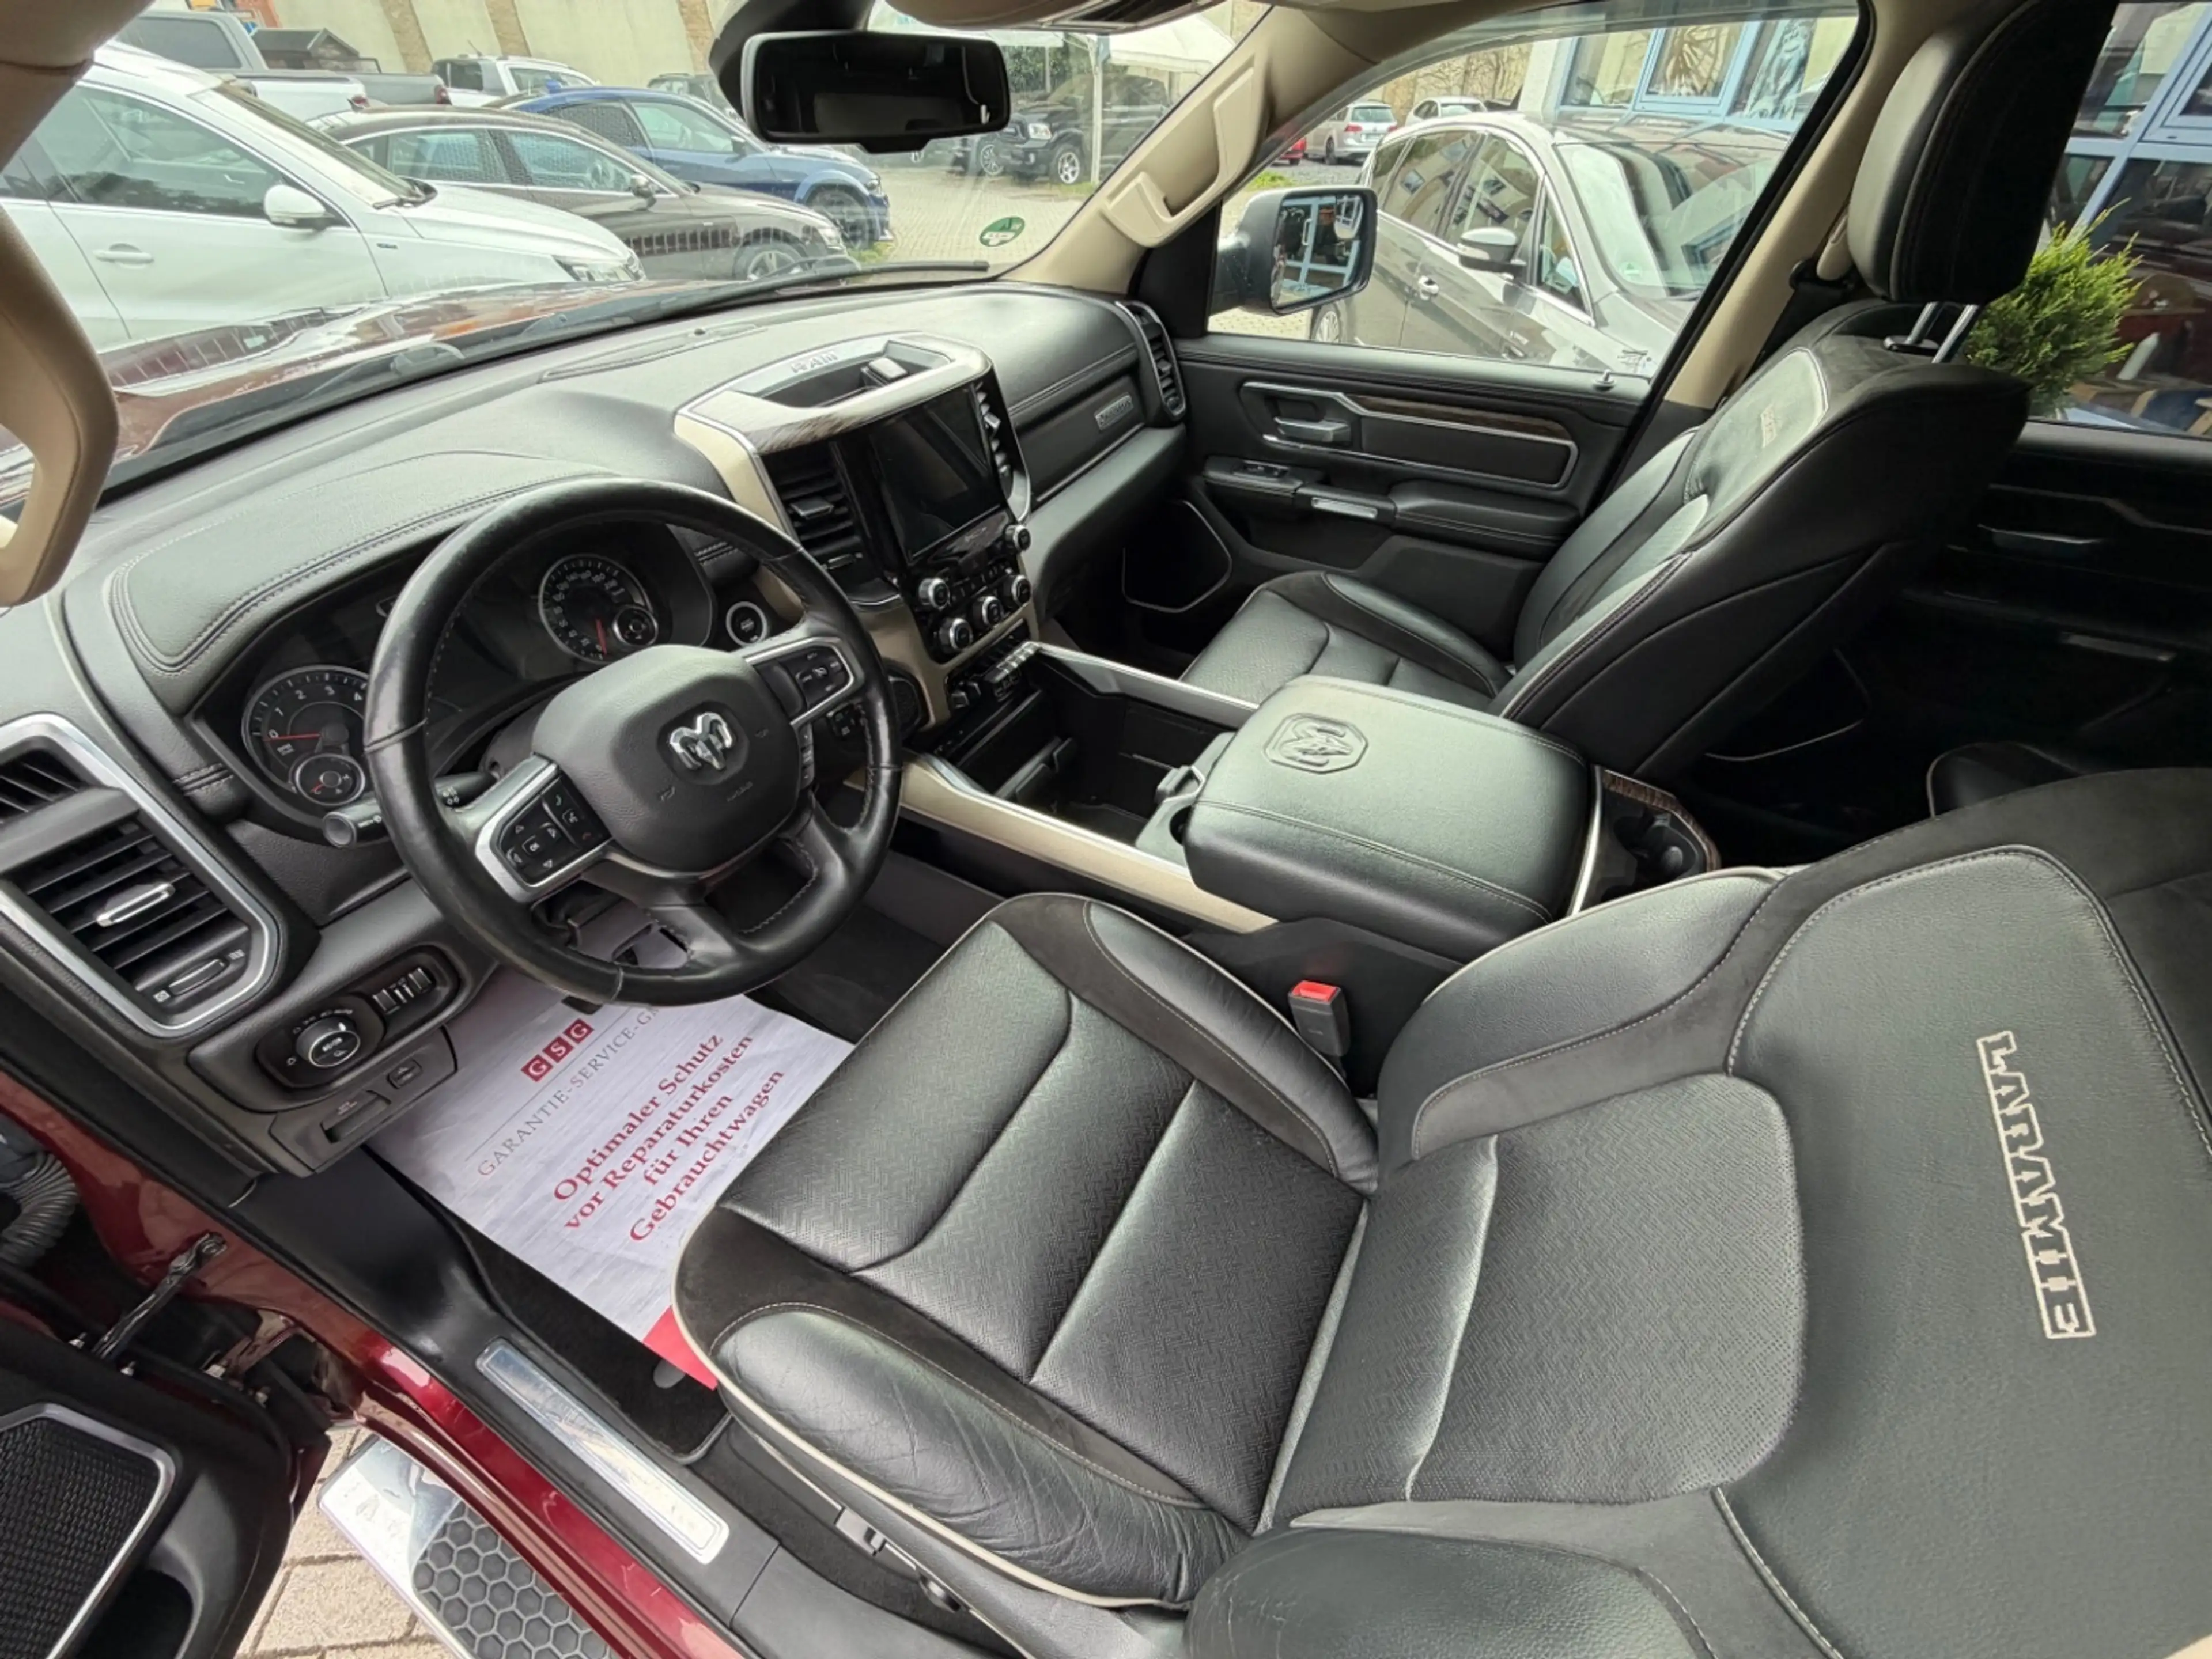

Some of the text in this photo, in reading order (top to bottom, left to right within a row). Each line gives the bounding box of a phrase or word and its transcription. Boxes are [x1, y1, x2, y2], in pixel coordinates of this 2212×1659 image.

[268, 728, 279, 738] 0
[274, 707, 284, 716] 1
[294, 689, 306, 700] 2
[524, 1021, 590, 1078] GSG
[553, 1034, 723, 1202] Optimaler Schutz
[564, 1036, 753, 1232] vor Reparaturkosten
[629, 1070, 785, 1241] Gebrauchtwagen
[642, 1093, 734, 1187] für Ihren
[1976, 1031, 2096, 1339] LARAMIE
